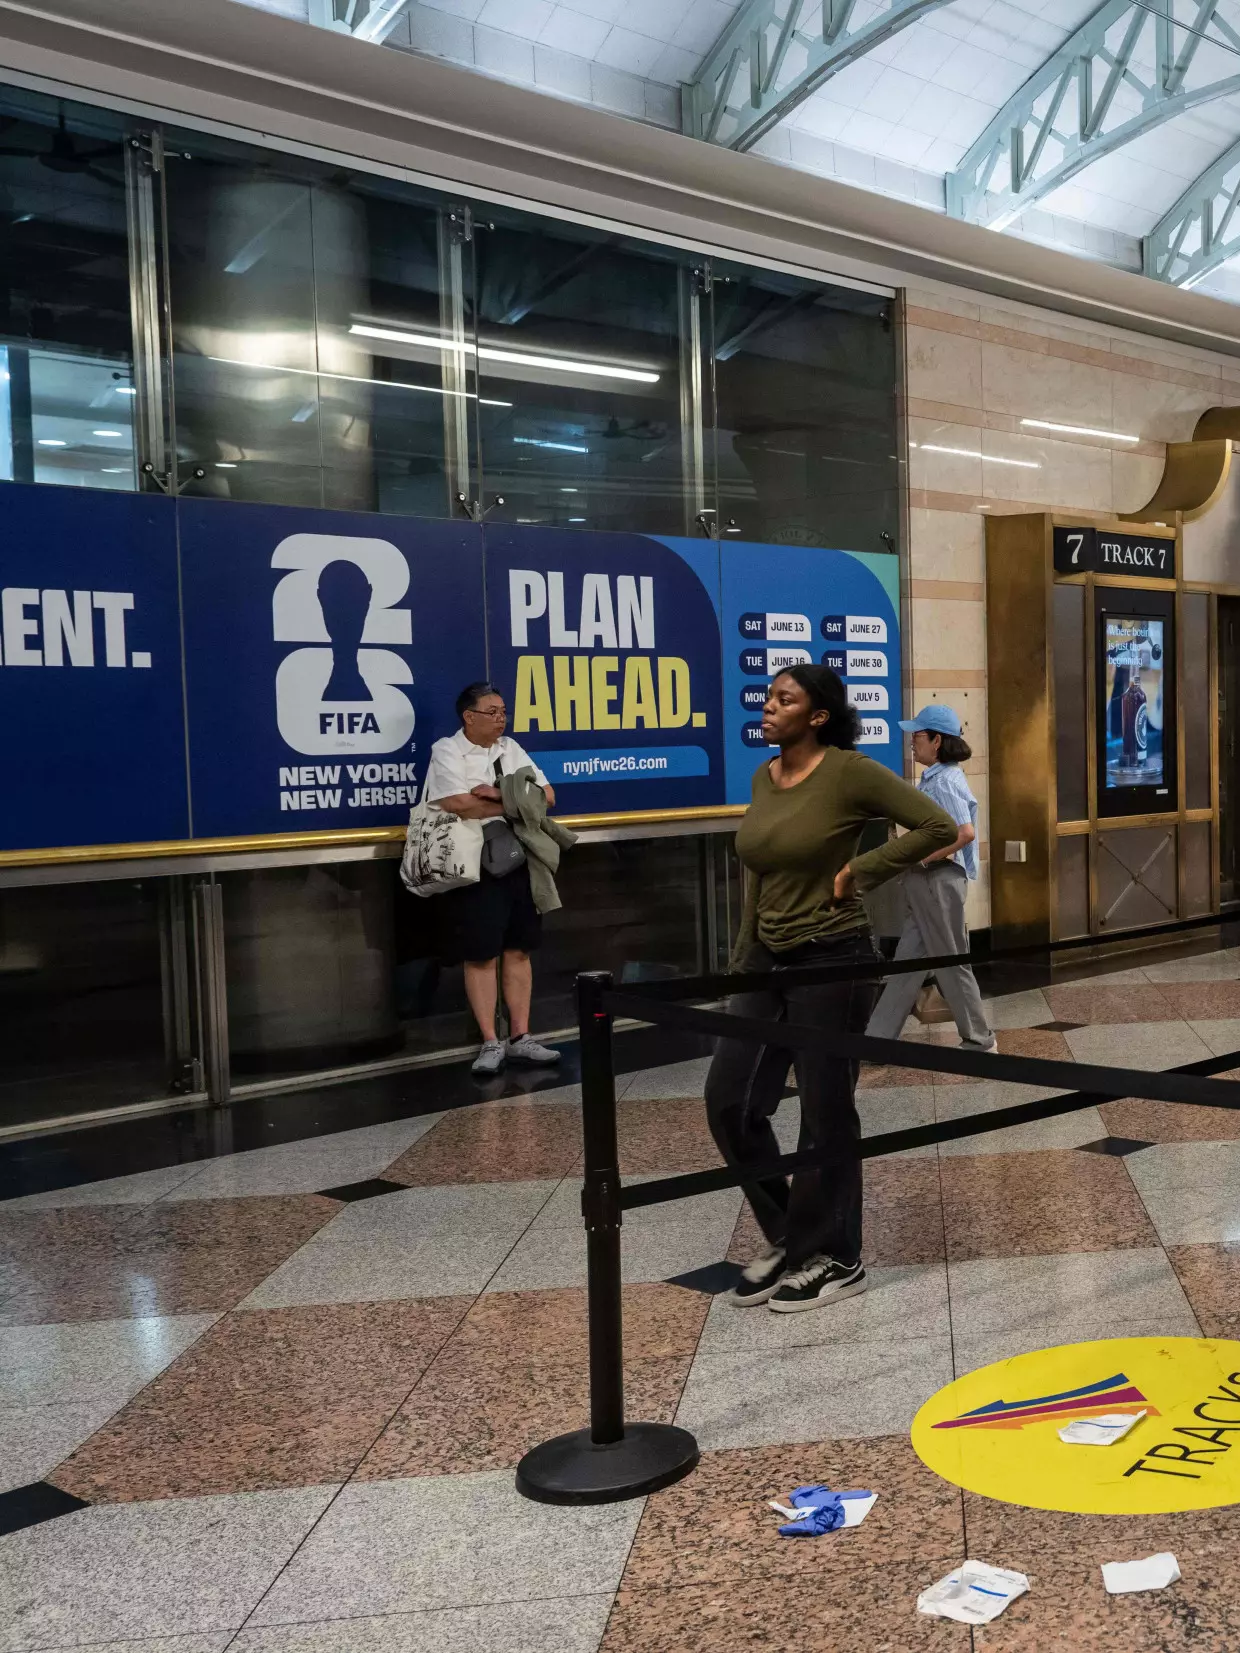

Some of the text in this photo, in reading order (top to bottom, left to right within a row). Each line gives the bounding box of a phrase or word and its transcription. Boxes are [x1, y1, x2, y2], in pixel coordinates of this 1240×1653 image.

[1066, 534, 1084, 564] 7
[1101, 543, 1166, 569] TRACK 7
[509, 569, 655, 649] PLAN
[0, 586, 152, 669] ENT.
[745, 620, 805, 632] SAT JUNE 13
[827, 622, 881, 634] SAT JUNE 27
[1115, 641, 1129, 652] just
[746, 656, 805, 667] TUE JUNE 16
[828, 657, 882, 668] TUE JUNE 30
[1108, 655, 1143, 668] beginning
[513, 655, 707, 733] AHEAD.
[745, 692, 765, 703] MON
[854, 692, 880, 702] JULY 5
[319, 712, 381, 735] FIFA
[747, 728, 763, 739] THU
[873, 726, 883, 735] 19
[411, 742, 417, 753] TM
[563, 755, 667, 775] nynjfwc26.com
[279, 762, 417, 787] NEW YORK
[280, 785, 418, 811] NEW JERSEY
